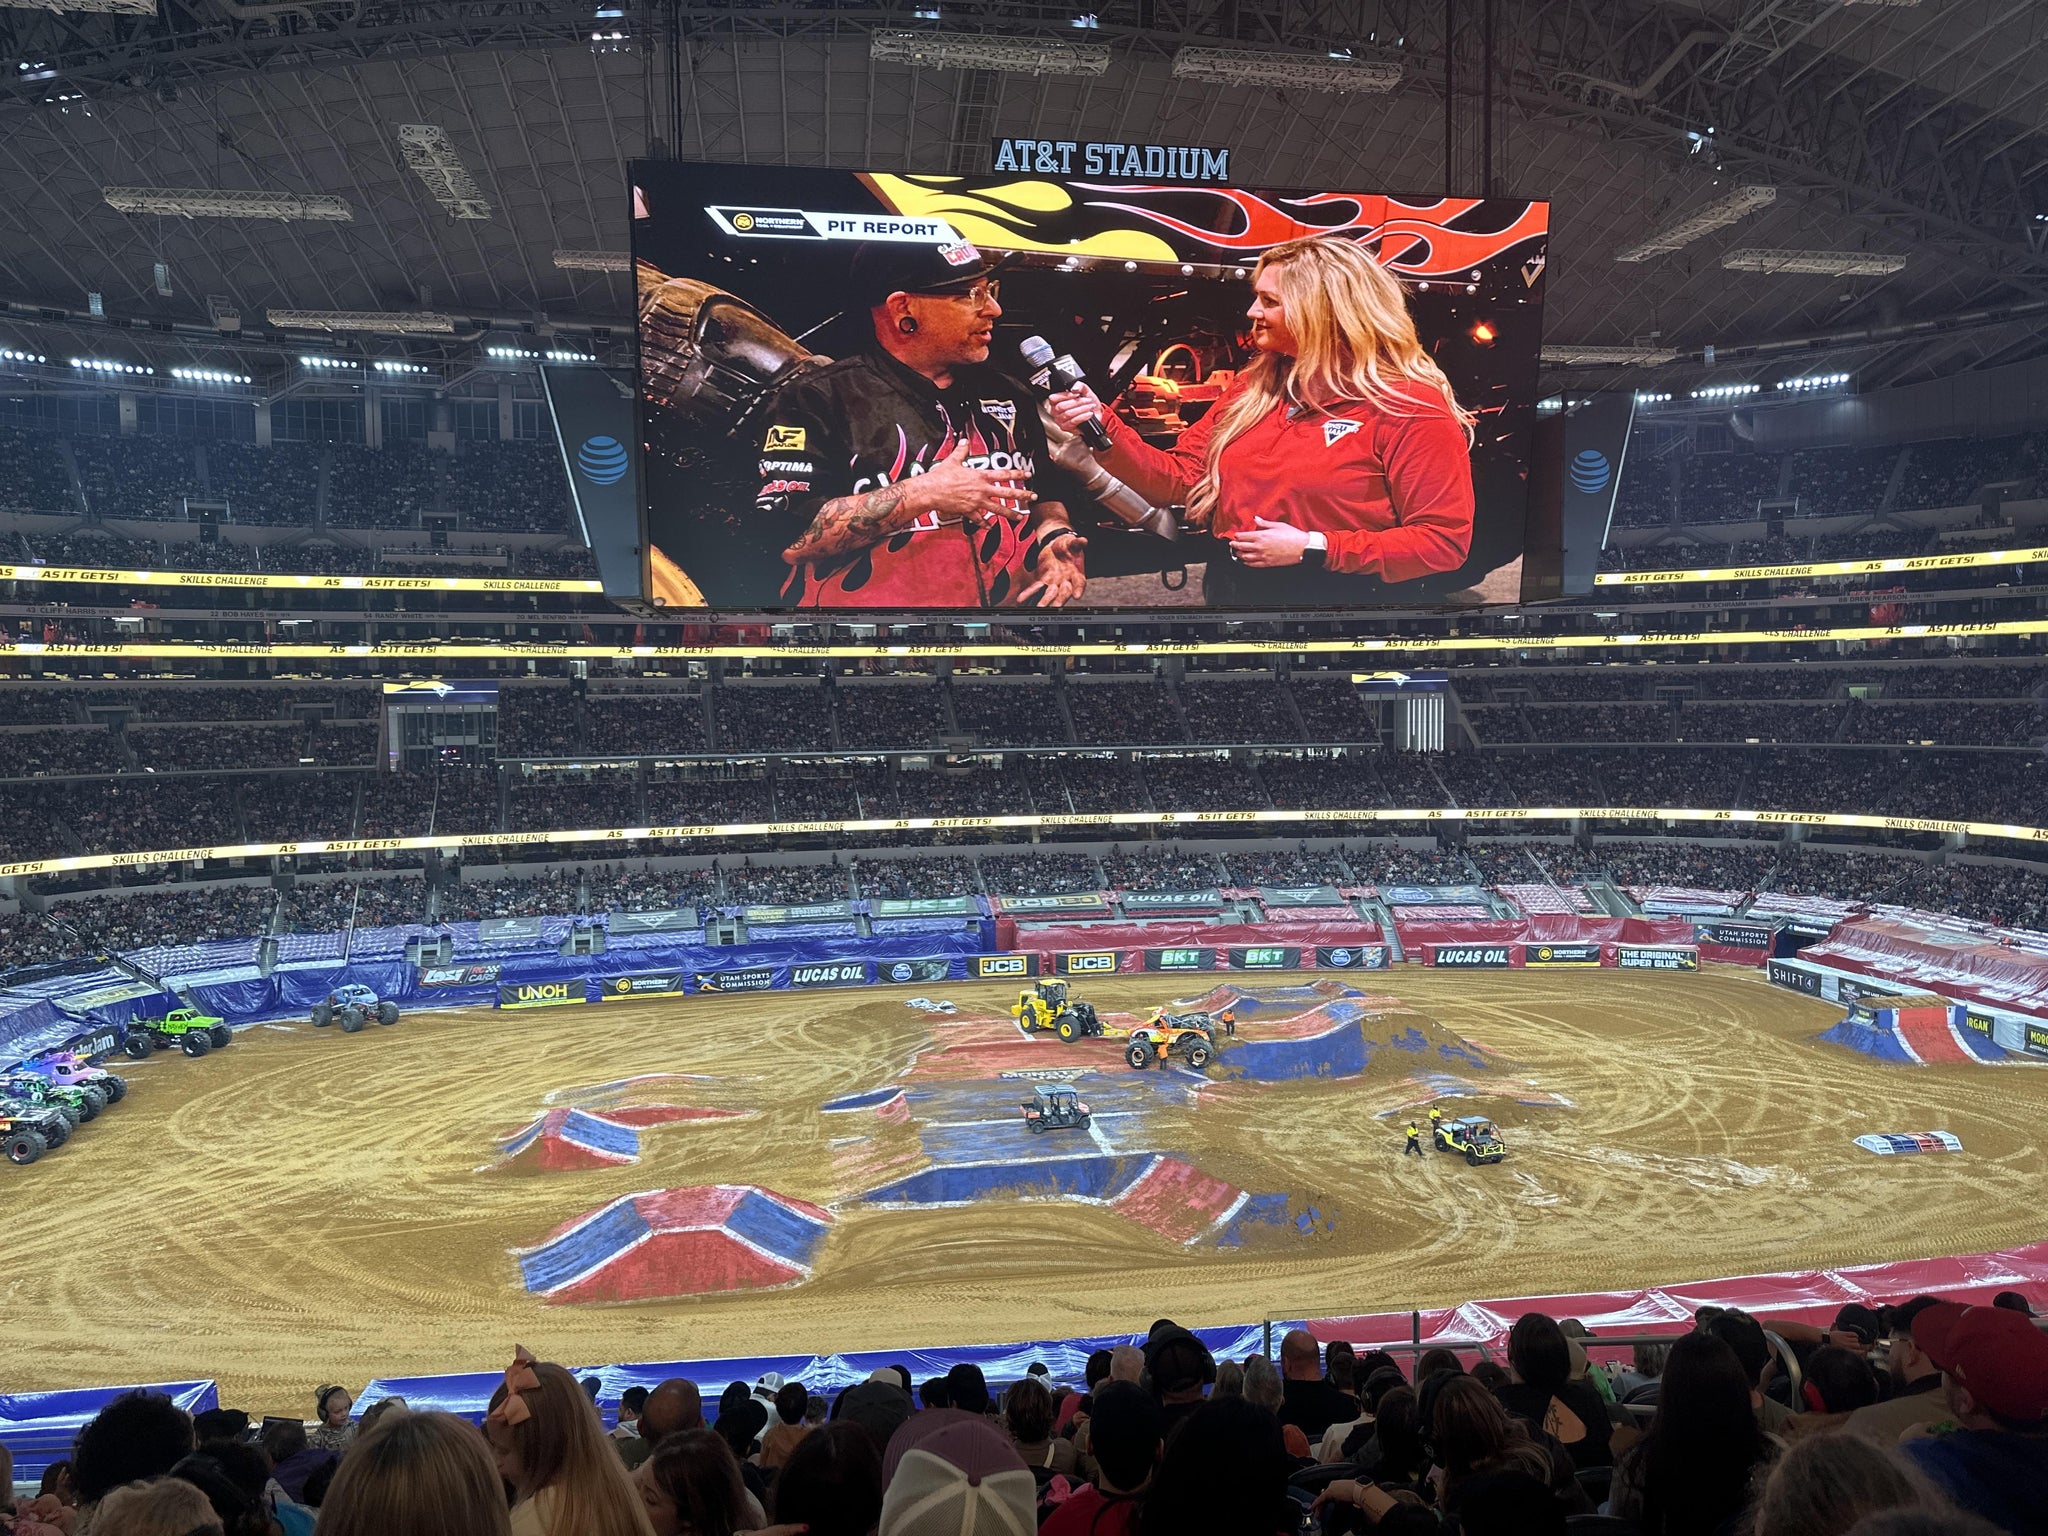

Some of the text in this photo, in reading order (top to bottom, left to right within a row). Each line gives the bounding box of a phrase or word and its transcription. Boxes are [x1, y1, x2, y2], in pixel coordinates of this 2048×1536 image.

[995, 139, 1229, 180] AT&T STADIUM
[755, 216, 803, 225] NORTHERN
[828, 220, 938, 236] PIT REPORT
[764, 461, 813, 472] OPTIMA
[1866, 562, 1882, 570] AS
[1906, 560, 1922, 568] AS
[1939, 556, 1975, 565] GETS!
[41, 570, 119, 580] AS IT GETS!
[1734, 566, 1813, 577] SKILLS CHALLENGE
[180, 576, 268, 585] SKILLS CHALLENGE
[365, 579, 382, 587] AS
[483, 581, 560, 590] SKILLS CHALLENGE
[1961, 623, 1997, 631] GETS!
[1782, 629, 1831, 637] CHALLENGE
[1268, 642, 1308, 650] CHALLENGE
[1412, 639, 1440, 647] GETS!
[85, 645, 123, 653] GETS!
[219, 645, 272, 654] CHALLENGE
[403, 646, 436, 654] GETS!
[520, 646, 567, 654] CHALLENGE
[1579, 810, 1658, 818] SKILLS CHALLENGE
[1790, 814, 1826, 822] GETS!
[962, 818, 992, 826] GETS!
[1040, 815, 1113, 824] SKILLS CHALLENGE
[767, 823, 844, 832] SKILLS CHALLENGE
[1884, 818, 1970, 832] SKILLS CHALLENGE
[681, 827, 714, 835] GETS!
[462, 833, 549, 846] SKILLS CHALLENGE
[326, 842, 345, 850] AS
[347, 841, 360, 849] IT
[364, 840, 401, 849] GETS!
[112, 849, 214, 864] SKILLS CHALLENGE
[1, 863, 44, 874] GETS!
[1008, 898, 1058, 906] JCB
[1127, 893, 1216, 902] LUCAS OIL
[1720, 929, 1736, 937] UTAH
[1719, 936, 1768, 945] COMMISSION
[1162, 951, 1198, 962] BKT
[1246, 951, 1284, 961] BKT
[1438, 950, 1506, 963] LUCAS OIL
[1641, 952, 1682, 960] ORIGINAL
[984, 960, 1023, 972] JCB
[1072, 956, 1112, 970] JCB
[1655, 960, 1678, 968] GLUE
[472, 966, 486, 974] RC
[794, 967, 863, 982] LUCAS OIL
[469, 973, 497, 982] CARS
[1774, 968, 1813, 987] SHIFT 4
[720, 980, 770, 989] COMMISSION
[519, 984, 568, 1000] UNOH
